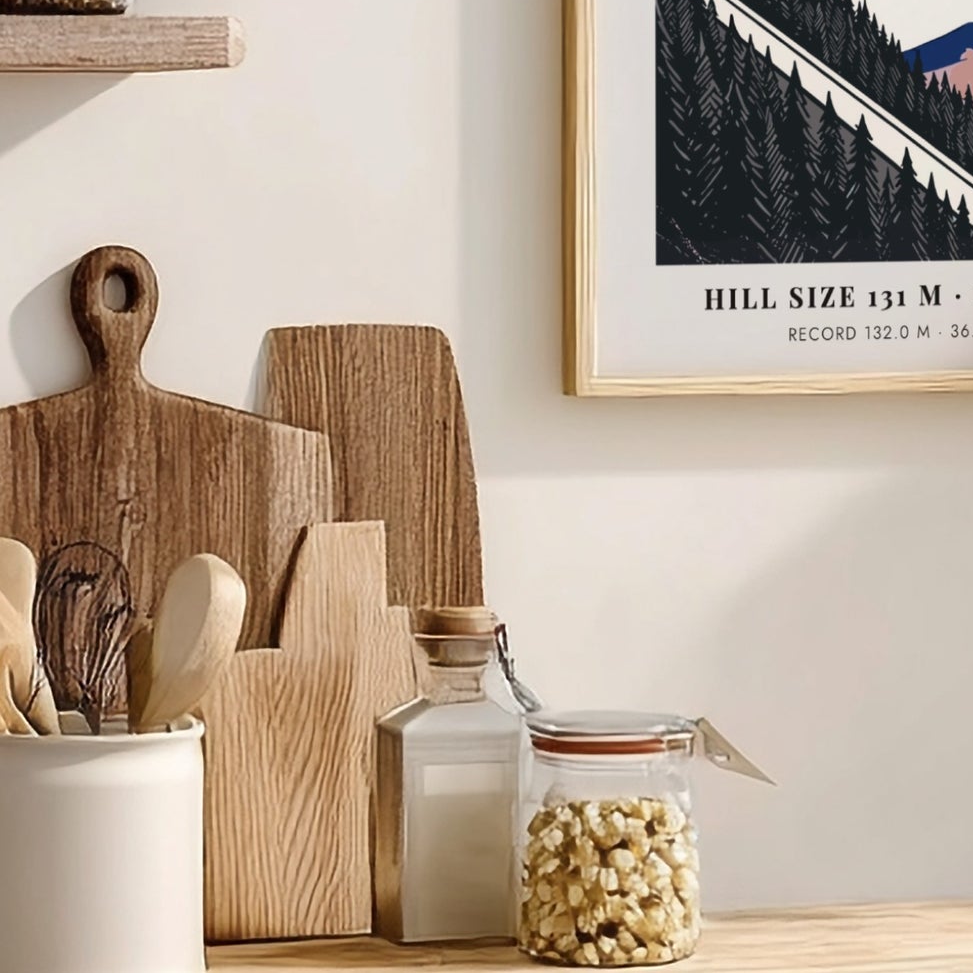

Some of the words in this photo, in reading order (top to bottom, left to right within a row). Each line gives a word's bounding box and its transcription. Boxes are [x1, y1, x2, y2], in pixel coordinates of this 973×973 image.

[704, 287, 777, 311] HILL
[789, 286, 855, 310] SIZE
[868, 290, 906, 311] 131
[919, 284, 942, 307] M
[788, 326, 857, 342] RECORD
[864, 324, 910, 340] 132.0
[916, 325, 930, 339] M
